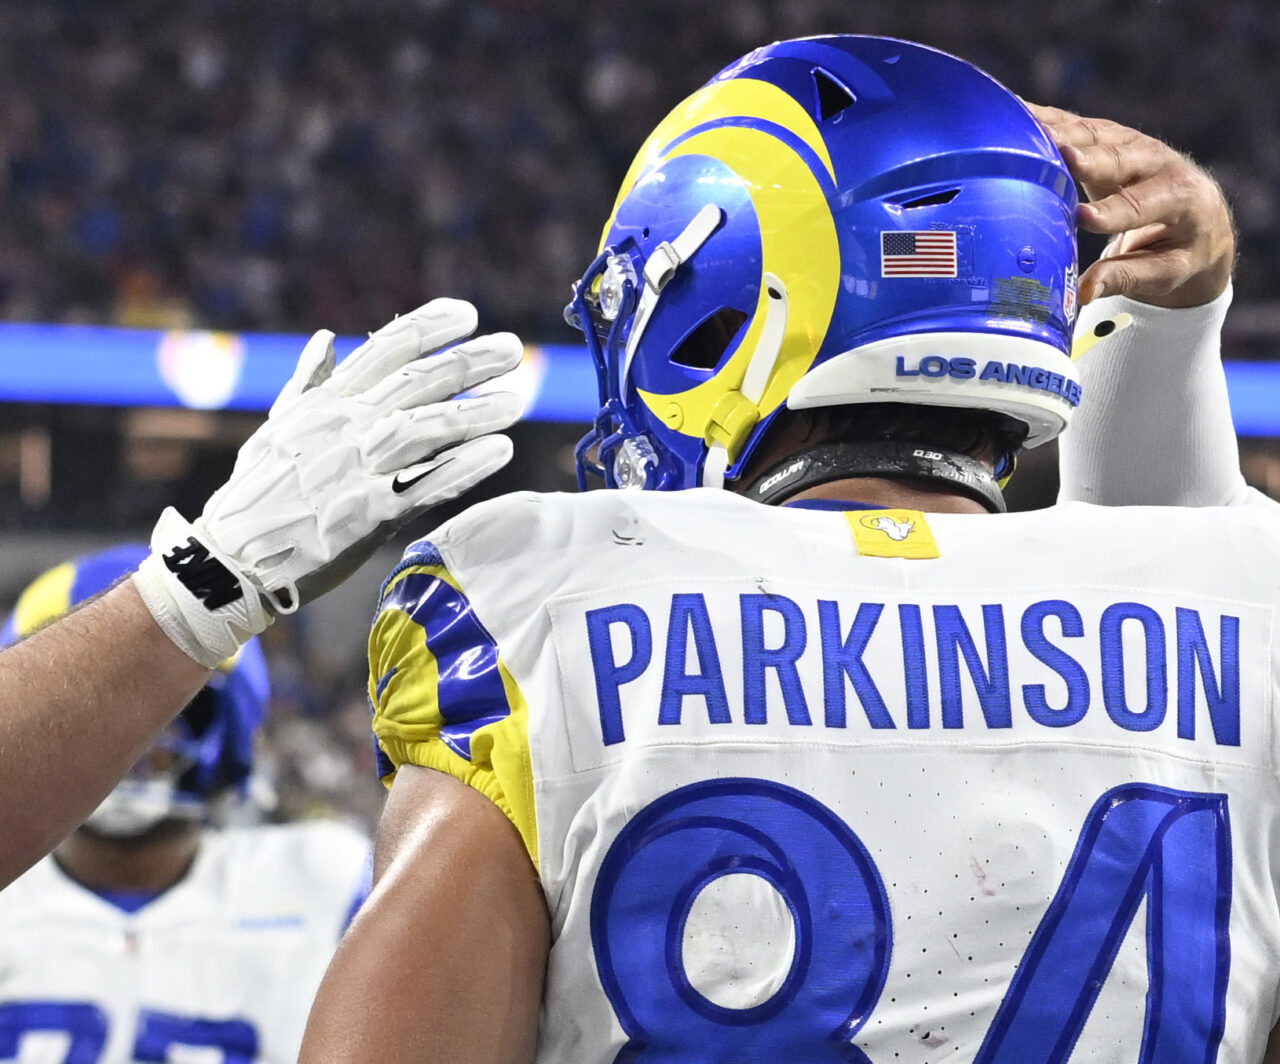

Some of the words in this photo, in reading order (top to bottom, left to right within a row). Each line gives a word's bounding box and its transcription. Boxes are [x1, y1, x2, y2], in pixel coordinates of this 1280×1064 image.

[895, 356, 977, 380] LOS
[979, 361, 1083, 407] ANGELES
[585, 593, 1242, 747] PARKINSON
